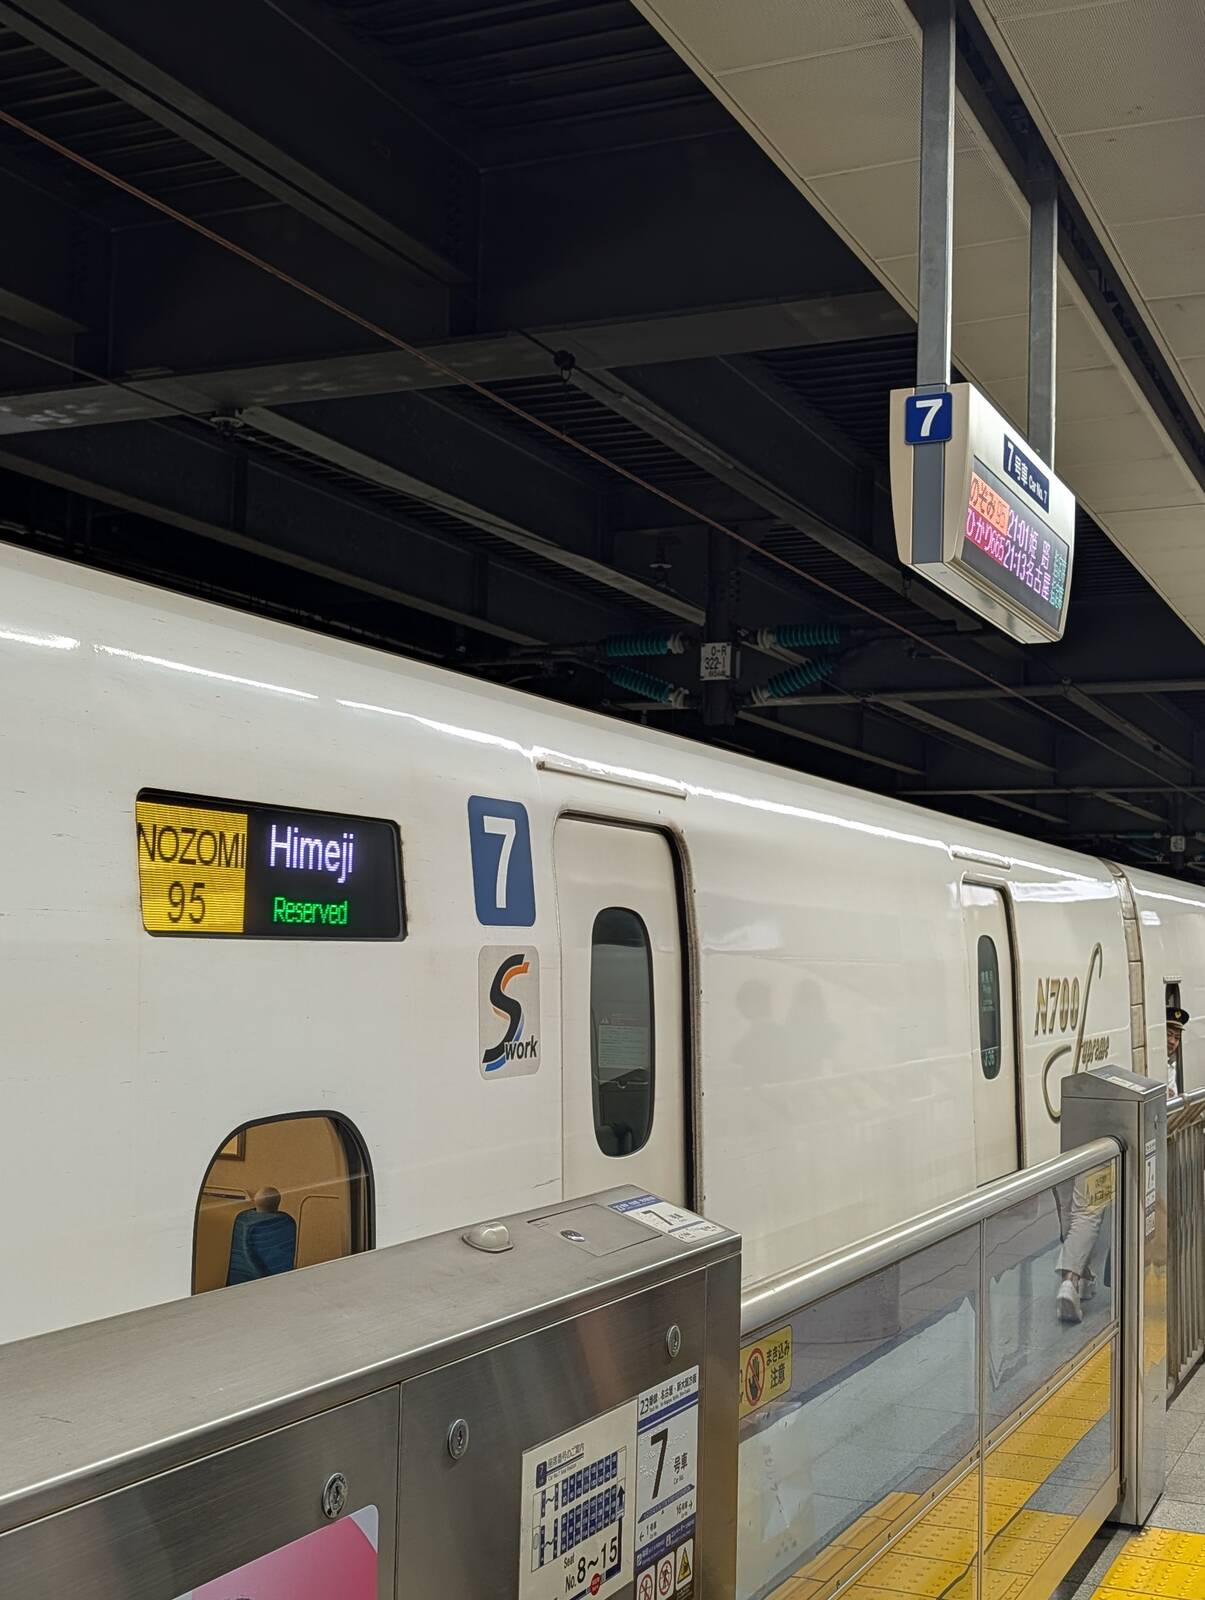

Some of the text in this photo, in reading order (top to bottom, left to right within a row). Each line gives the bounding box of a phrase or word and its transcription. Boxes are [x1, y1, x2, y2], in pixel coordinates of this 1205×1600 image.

[915, 398, 943, 437] 7
[1007, 509, 1030, 549] 21:01
[1003, 538, 1027, 581] 21:13
[137, 822, 246, 870] NOZOMI
[269, 823, 355, 885] Himeji
[483, 815, 517, 910] 7
[168, 881, 206, 925] 95
[273, 896, 348, 926] Reserved
[1034, 976, 1080, 1036] N700
[505, 1035, 538, 1060] work
[641, 1209, 674, 1226] 7
[770, 1363, 785, 1389] 注意
[650, 1427, 669, 1500] 7
[564, 1552, 575, 1569] Seat
[565, 1573, 577, 1593] No.
